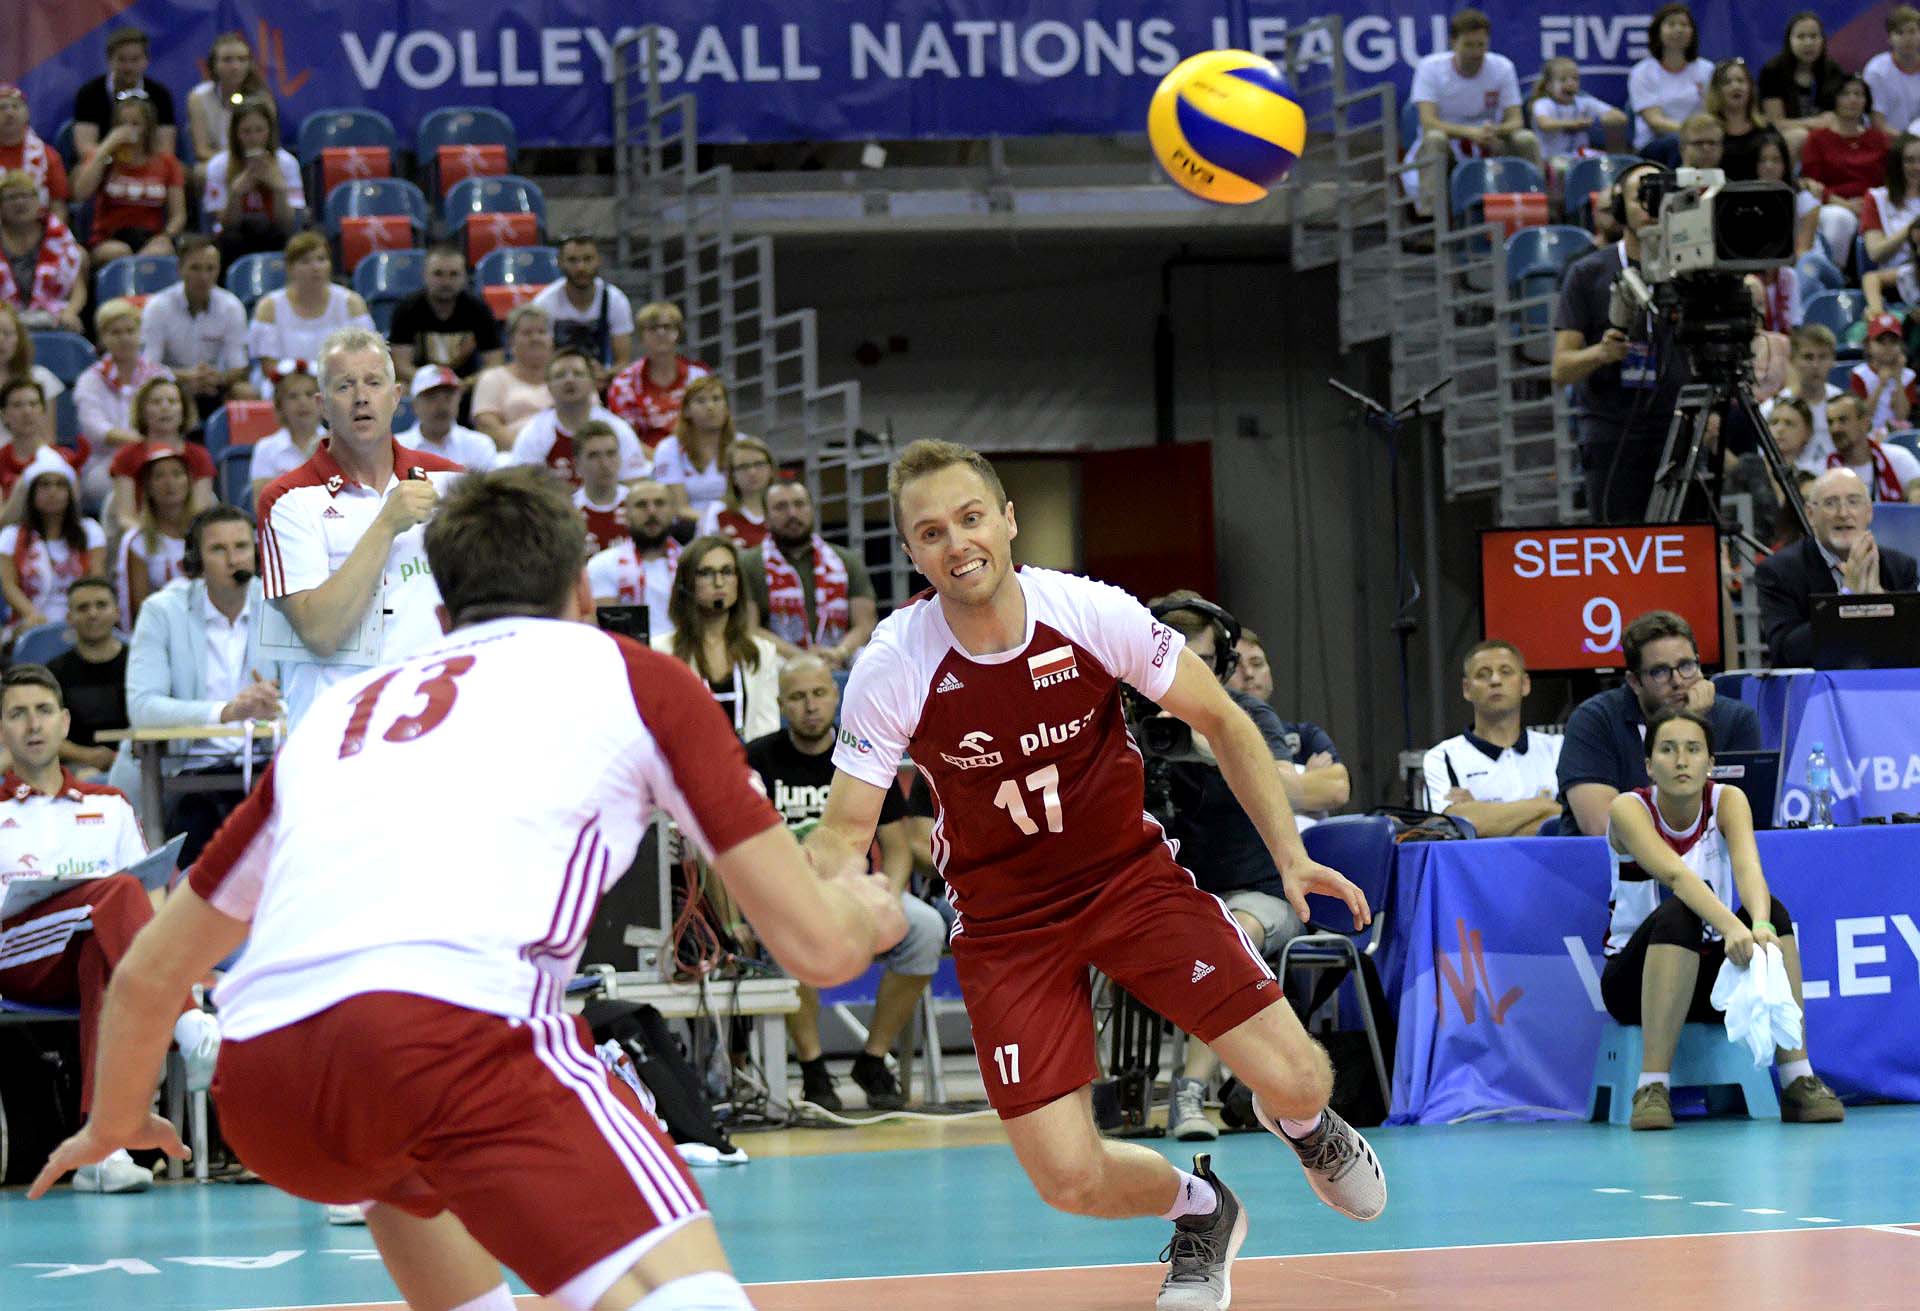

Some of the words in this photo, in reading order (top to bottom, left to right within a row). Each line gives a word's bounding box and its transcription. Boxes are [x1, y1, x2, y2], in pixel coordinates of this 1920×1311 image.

[340, 24, 820, 90] VOLLEYBALL
[851, 18, 1180, 79] NATIONS
[1212, 14, 1448, 73] LEAGU
[1513, 534, 1687, 578] SERVE
[1582, 596, 1622, 653] 9
[936, 682, 965, 694] adidas
[1033, 668, 1080, 691] POLSKA
[338, 654, 476, 760] 13
[1020, 722, 1081, 756] plus
[993, 763, 1064, 836] 17
[56, 857, 95, 876] plus
[1191, 965, 1216, 984] adidas
[993, 1043, 1021, 1085] 17
